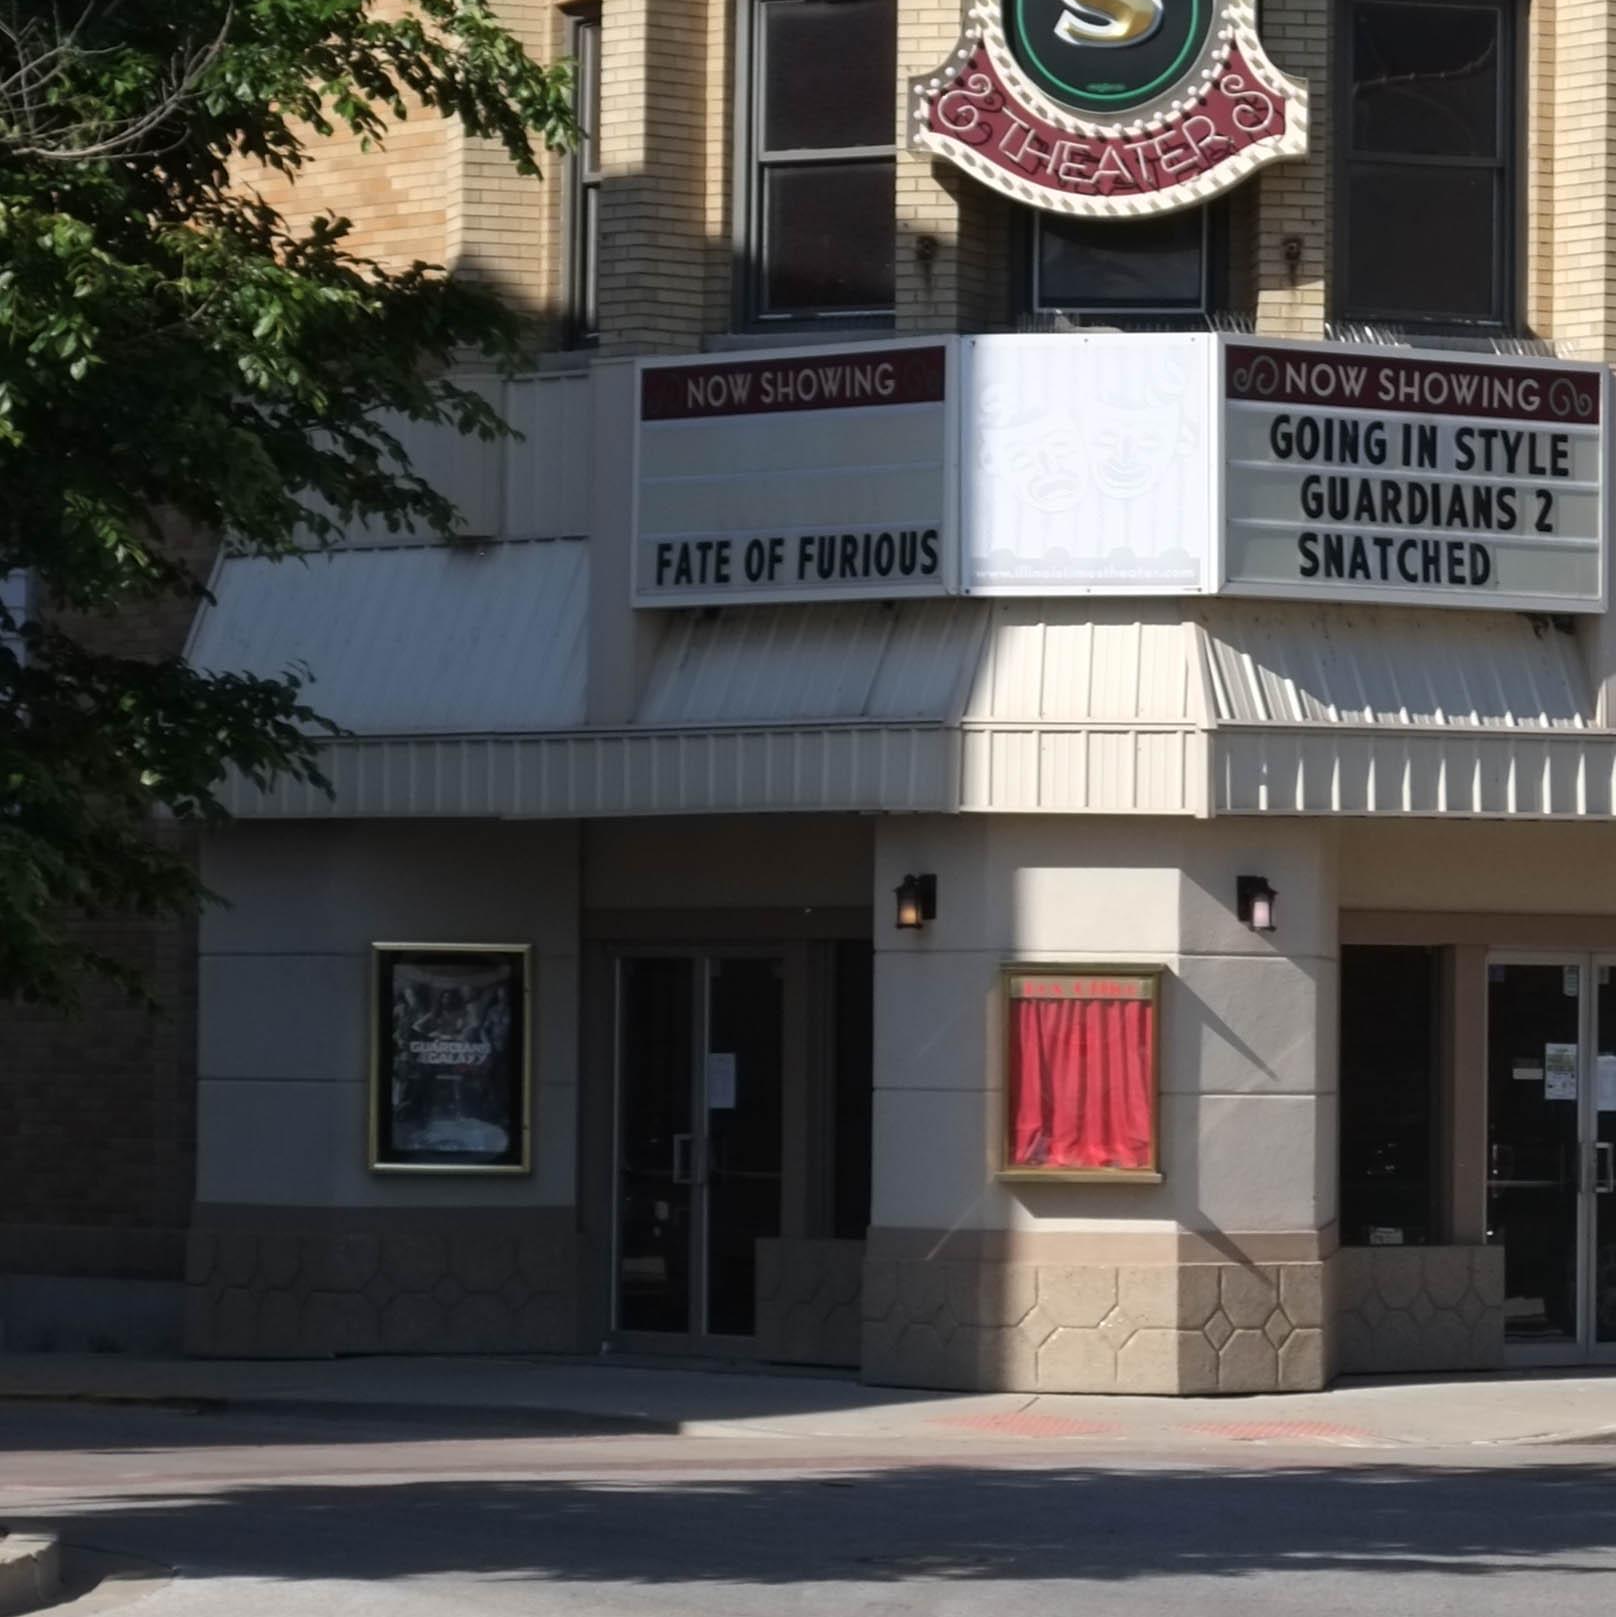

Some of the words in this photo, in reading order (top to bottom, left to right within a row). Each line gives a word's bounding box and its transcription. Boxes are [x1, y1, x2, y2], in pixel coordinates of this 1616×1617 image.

[999, 107, 1230, 183] THEATER
[687, 372, 752, 408] NOW
[761, 363, 896, 404] SHOWING
[1285, 361, 1368, 397] NOW
[1378, 368, 1540, 411] SHOWING
[1270, 414, 1387, 465] GOING
[1402, 423, 1437, 467] IN
[1455, 427, 1569, 476] STYLE
[1301, 475, 1516, 530] GUARDIANS
[1535, 489, 1553, 532] 2
[656, 540, 731, 586] FATE
[744, 537, 784, 582] OF
[798, 529, 939, 579] FURIOUS
[1299, 532, 1491, 584] SNATCHED
